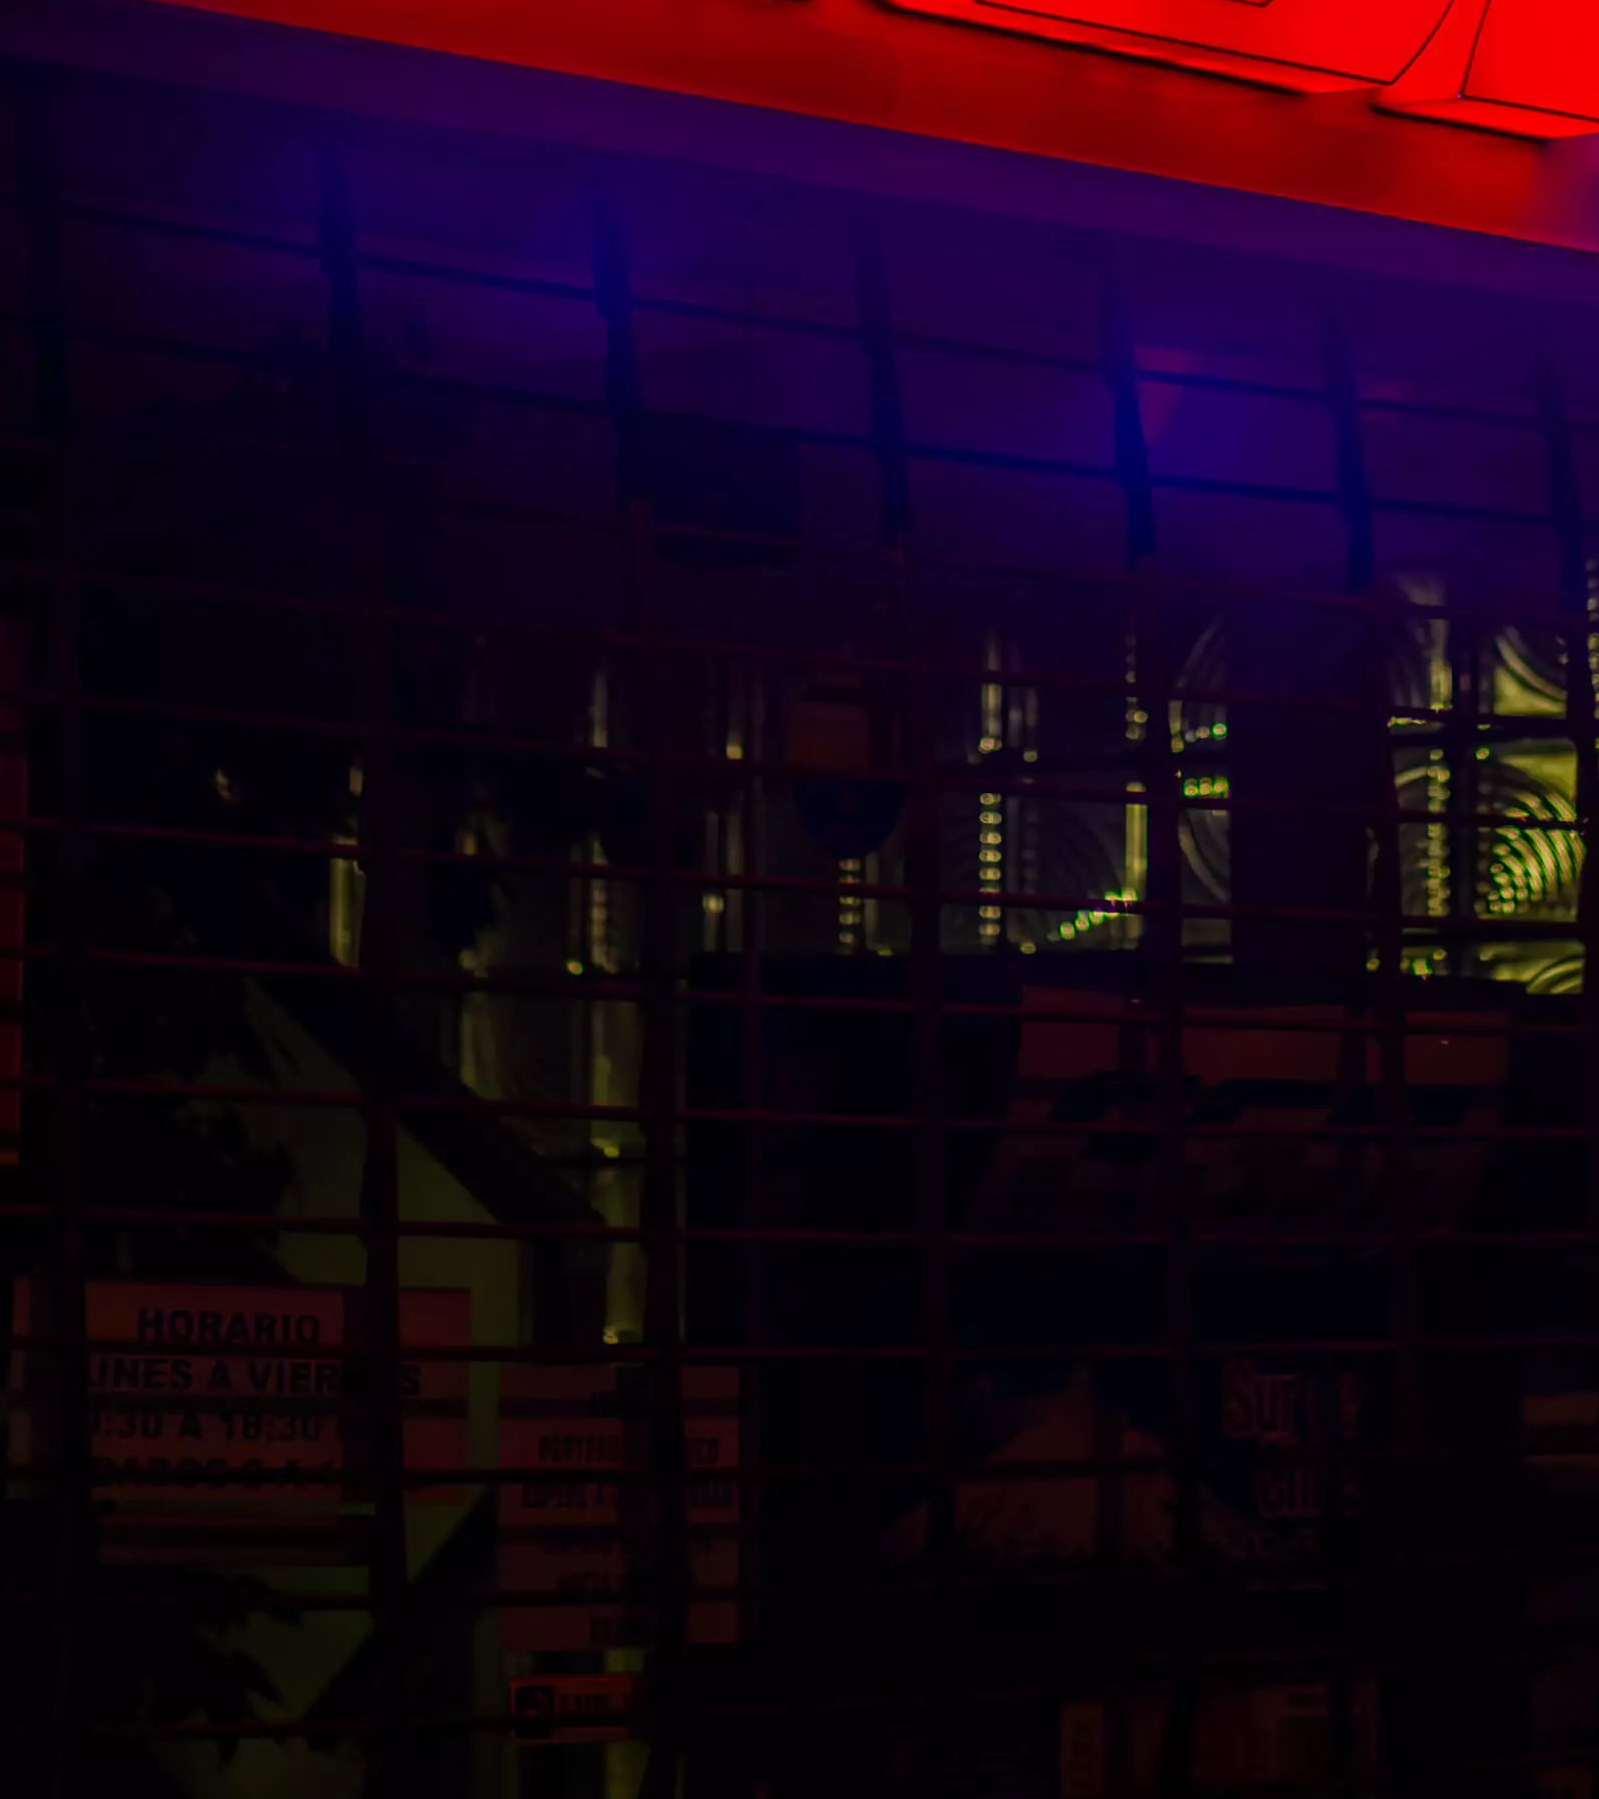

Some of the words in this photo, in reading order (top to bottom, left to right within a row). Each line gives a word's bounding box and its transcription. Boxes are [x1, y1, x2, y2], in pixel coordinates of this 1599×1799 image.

[137, 1308, 321, 1346] HORARIO
[86, 1357, 193, 1391] UNES
[207, 1359, 232, 1391] A
[179, 1407, 203, 1440] A
